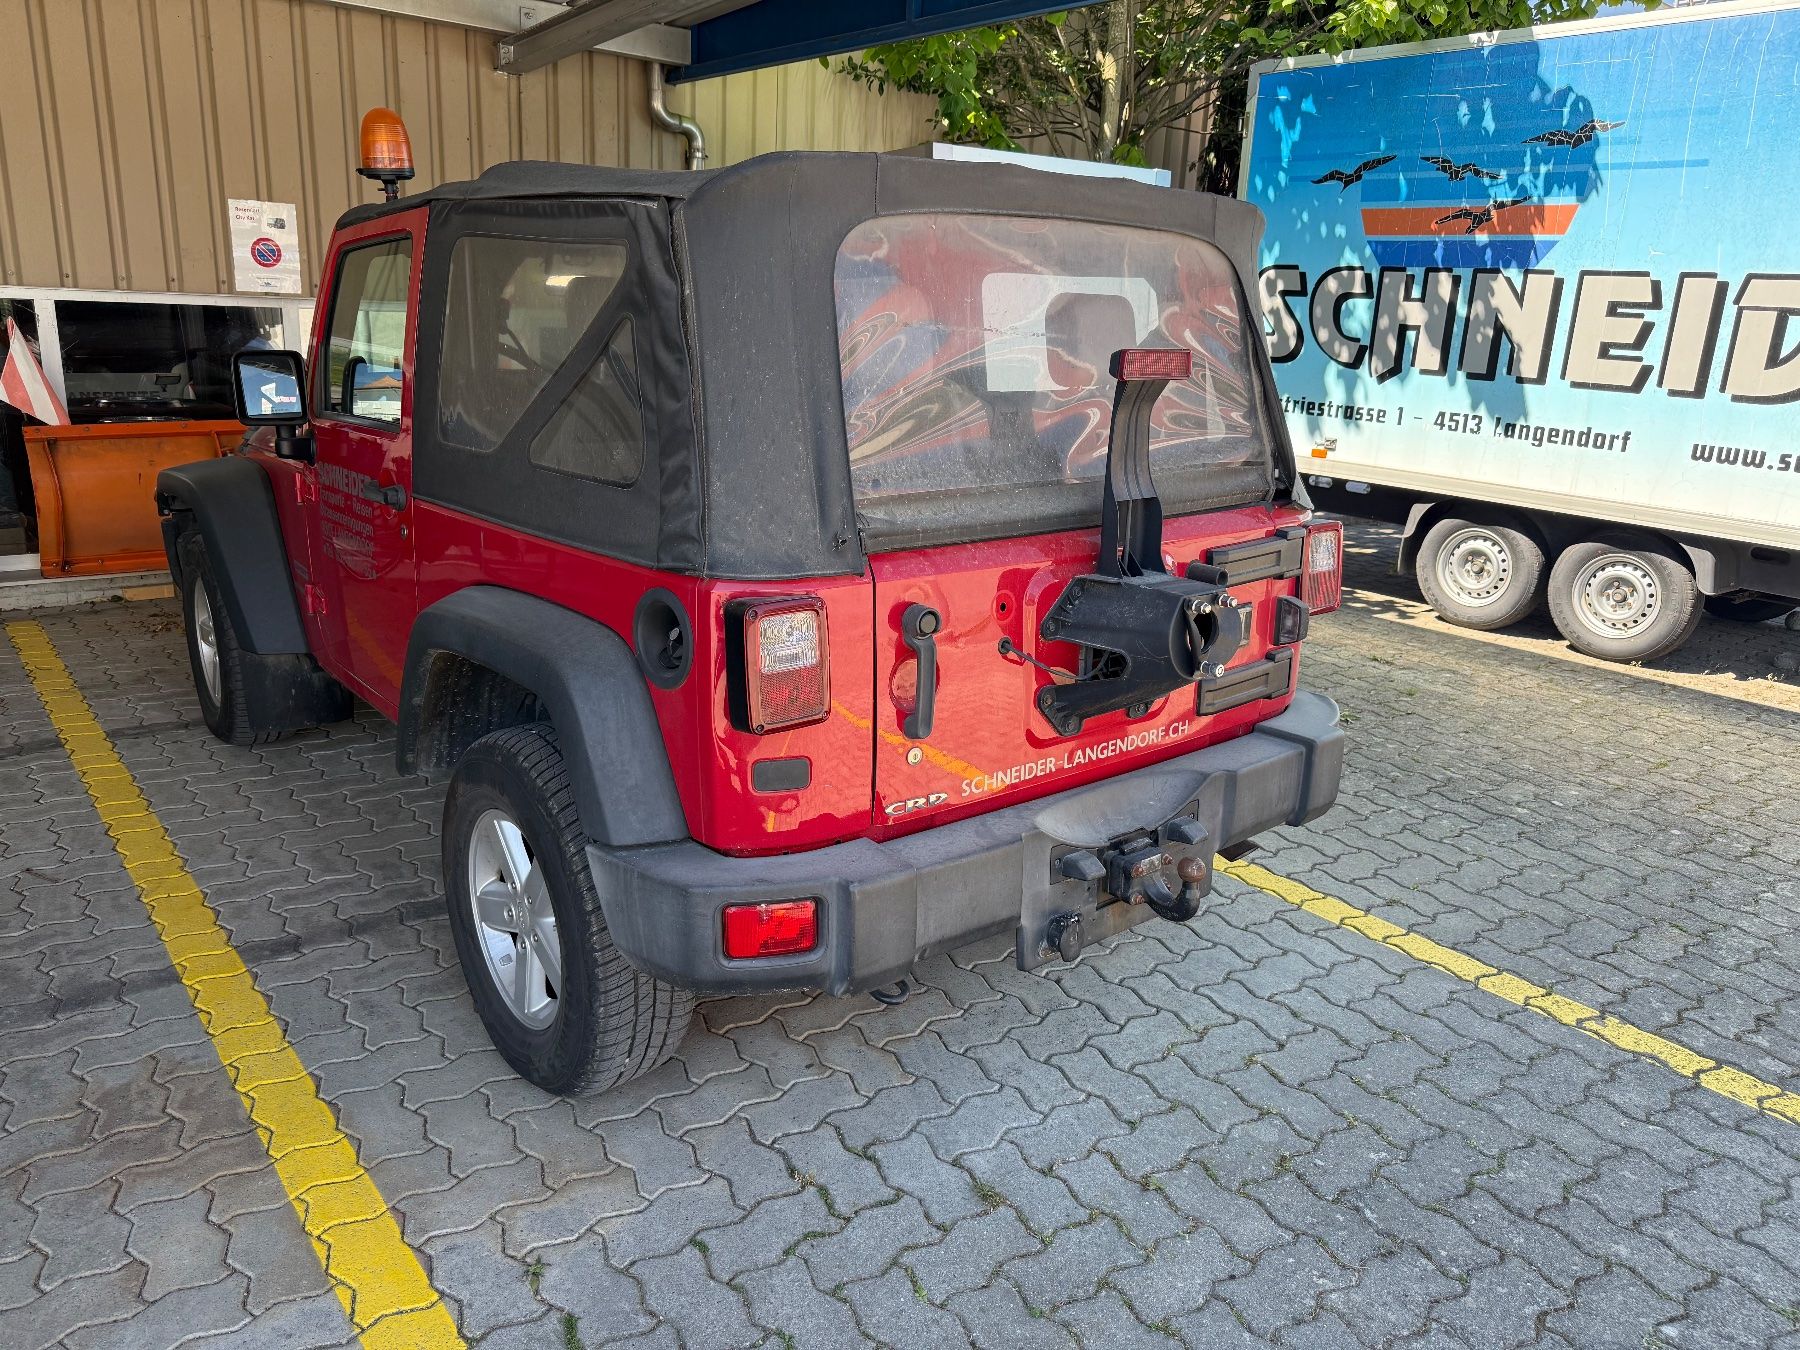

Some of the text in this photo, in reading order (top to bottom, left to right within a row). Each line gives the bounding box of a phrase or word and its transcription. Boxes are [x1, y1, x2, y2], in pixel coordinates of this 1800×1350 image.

[1258, 264, 1800, 405] SCHNEID
[1280, 396, 1386, 424] triestrasse
[1396, 406, 1404, 425] 1
[1433, 410, 1483, 435] 4513
[961, 719, 1189, 797] SCHNEIDER-LANGENDORF.CH
[884, 792, 948, 816] CRD
